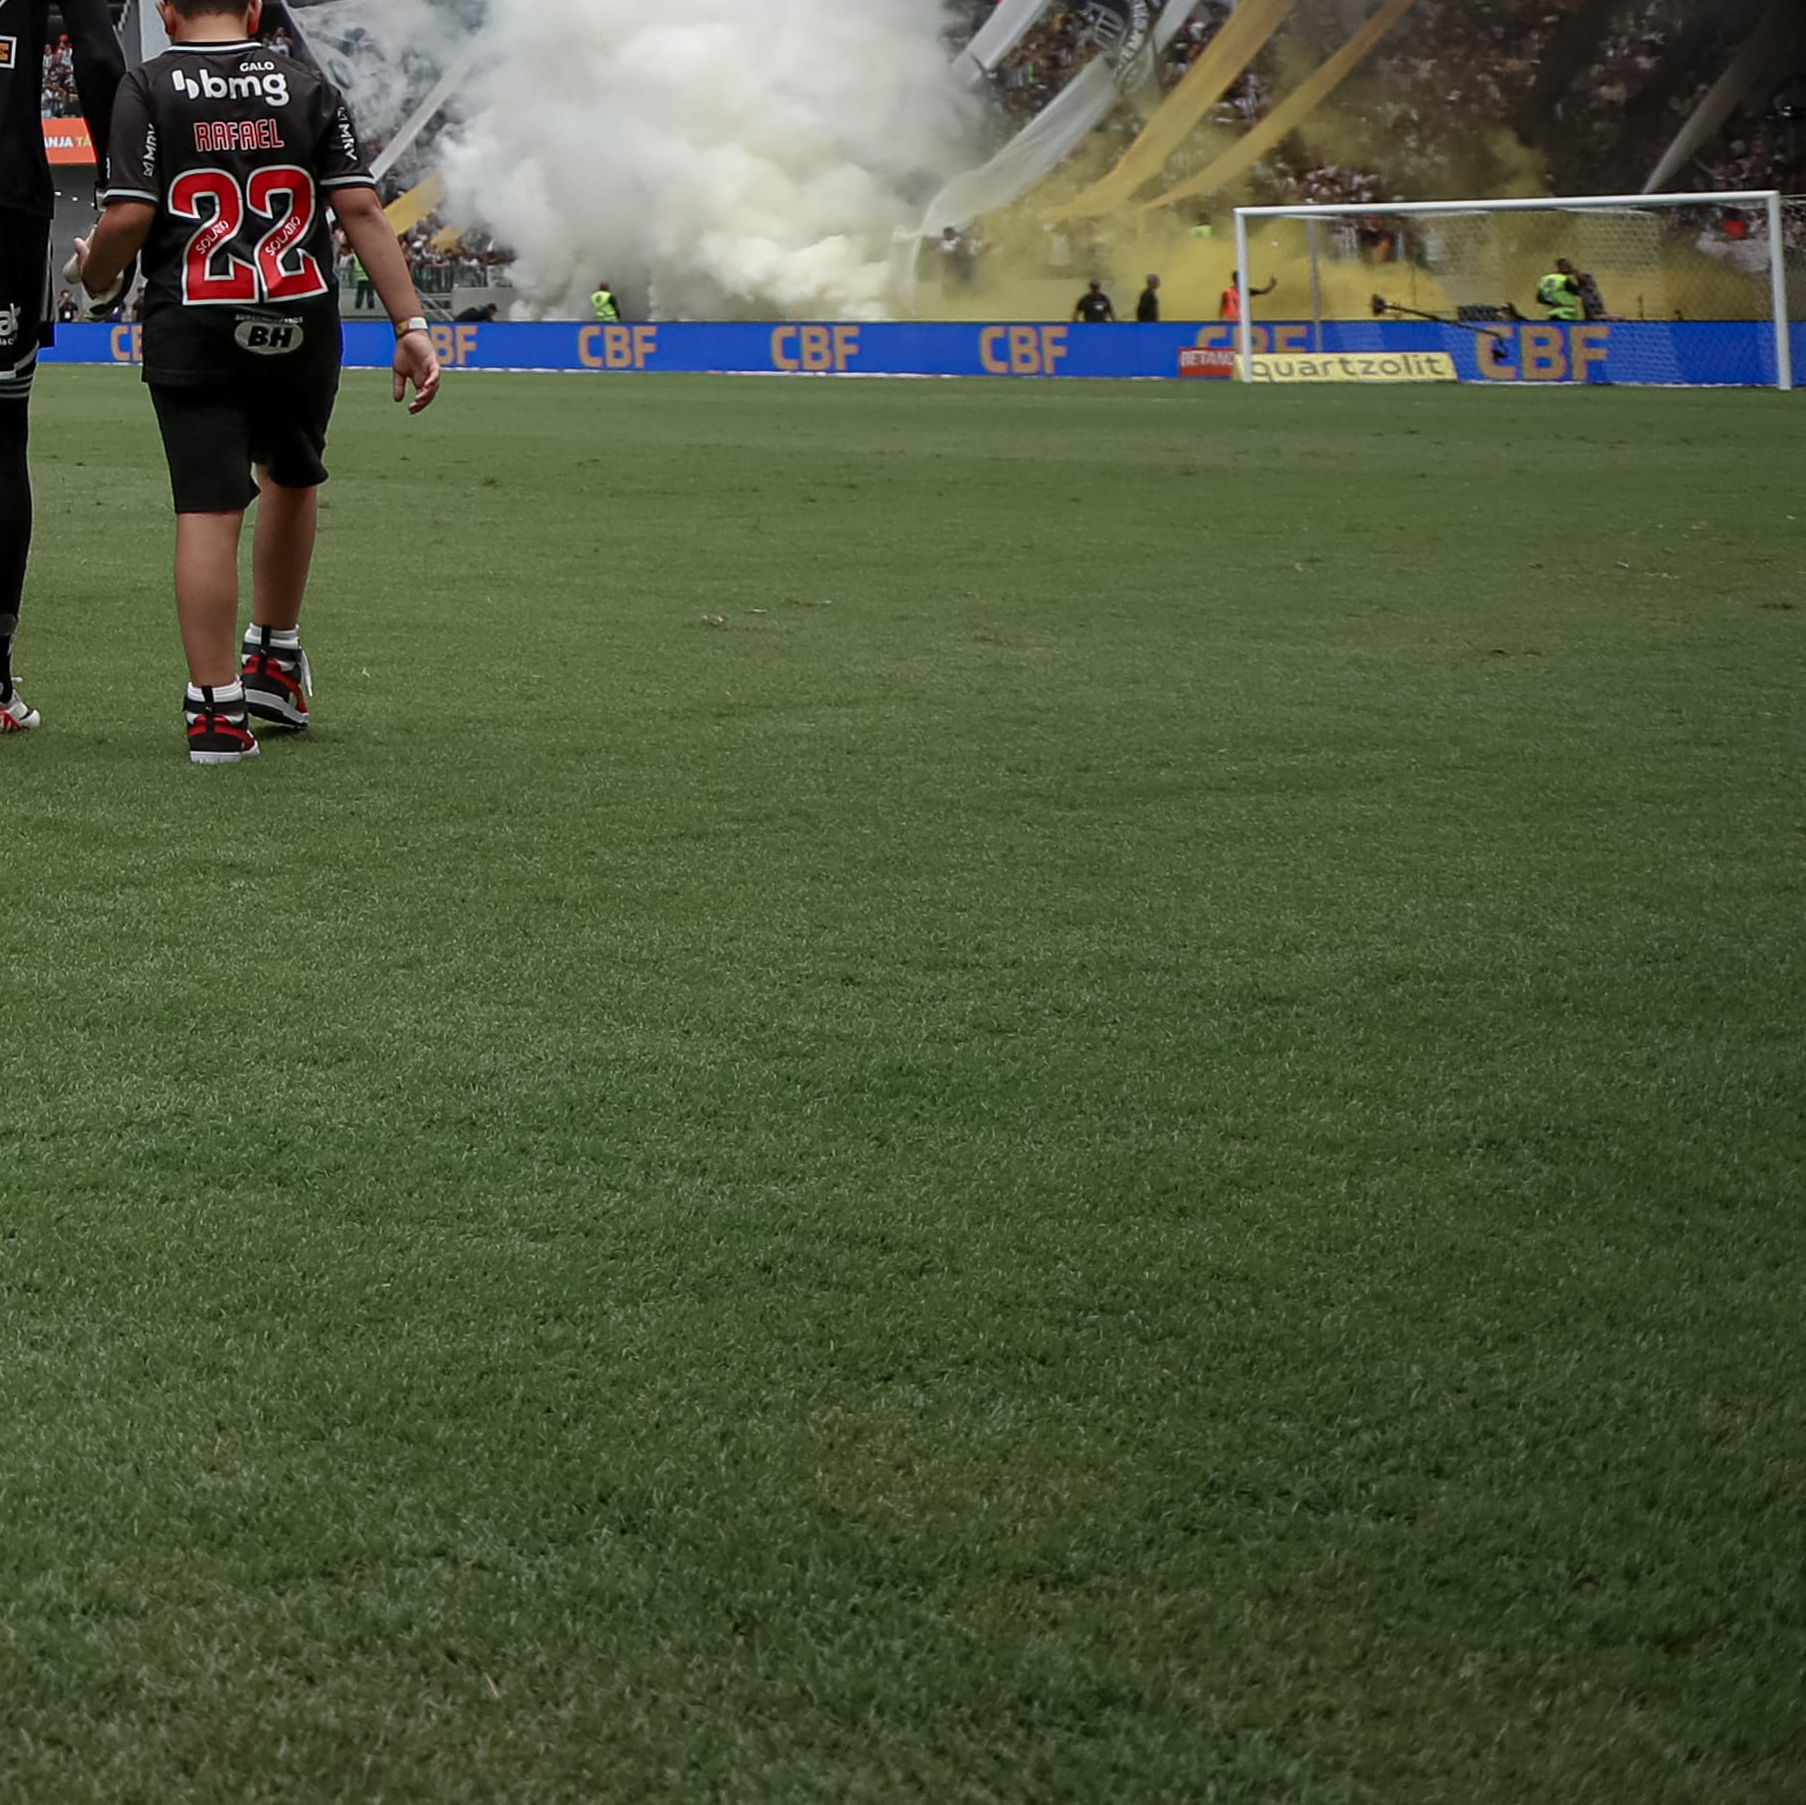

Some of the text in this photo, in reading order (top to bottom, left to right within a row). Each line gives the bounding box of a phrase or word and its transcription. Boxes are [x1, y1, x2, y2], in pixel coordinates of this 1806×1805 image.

[240, 61, 274, 72] GALO
[199, 69, 289, 106] bmg
[194, 119, 285, 151] RAFAEL
[168, 165, 329, 305] 22
[196, 220, 229, 254] SOLATIO
[265, 216, 301, 256] SOLATIO
[247, 325, 294, 347] BH
[578, 326, 657, 368] CBF
[770, 325, 860, 370] CBF
[979, 326, 1068, 373] CBF
[1477, 325, 1609, 380] CBF
[1250, 354, 1442, 380] quartzolit
